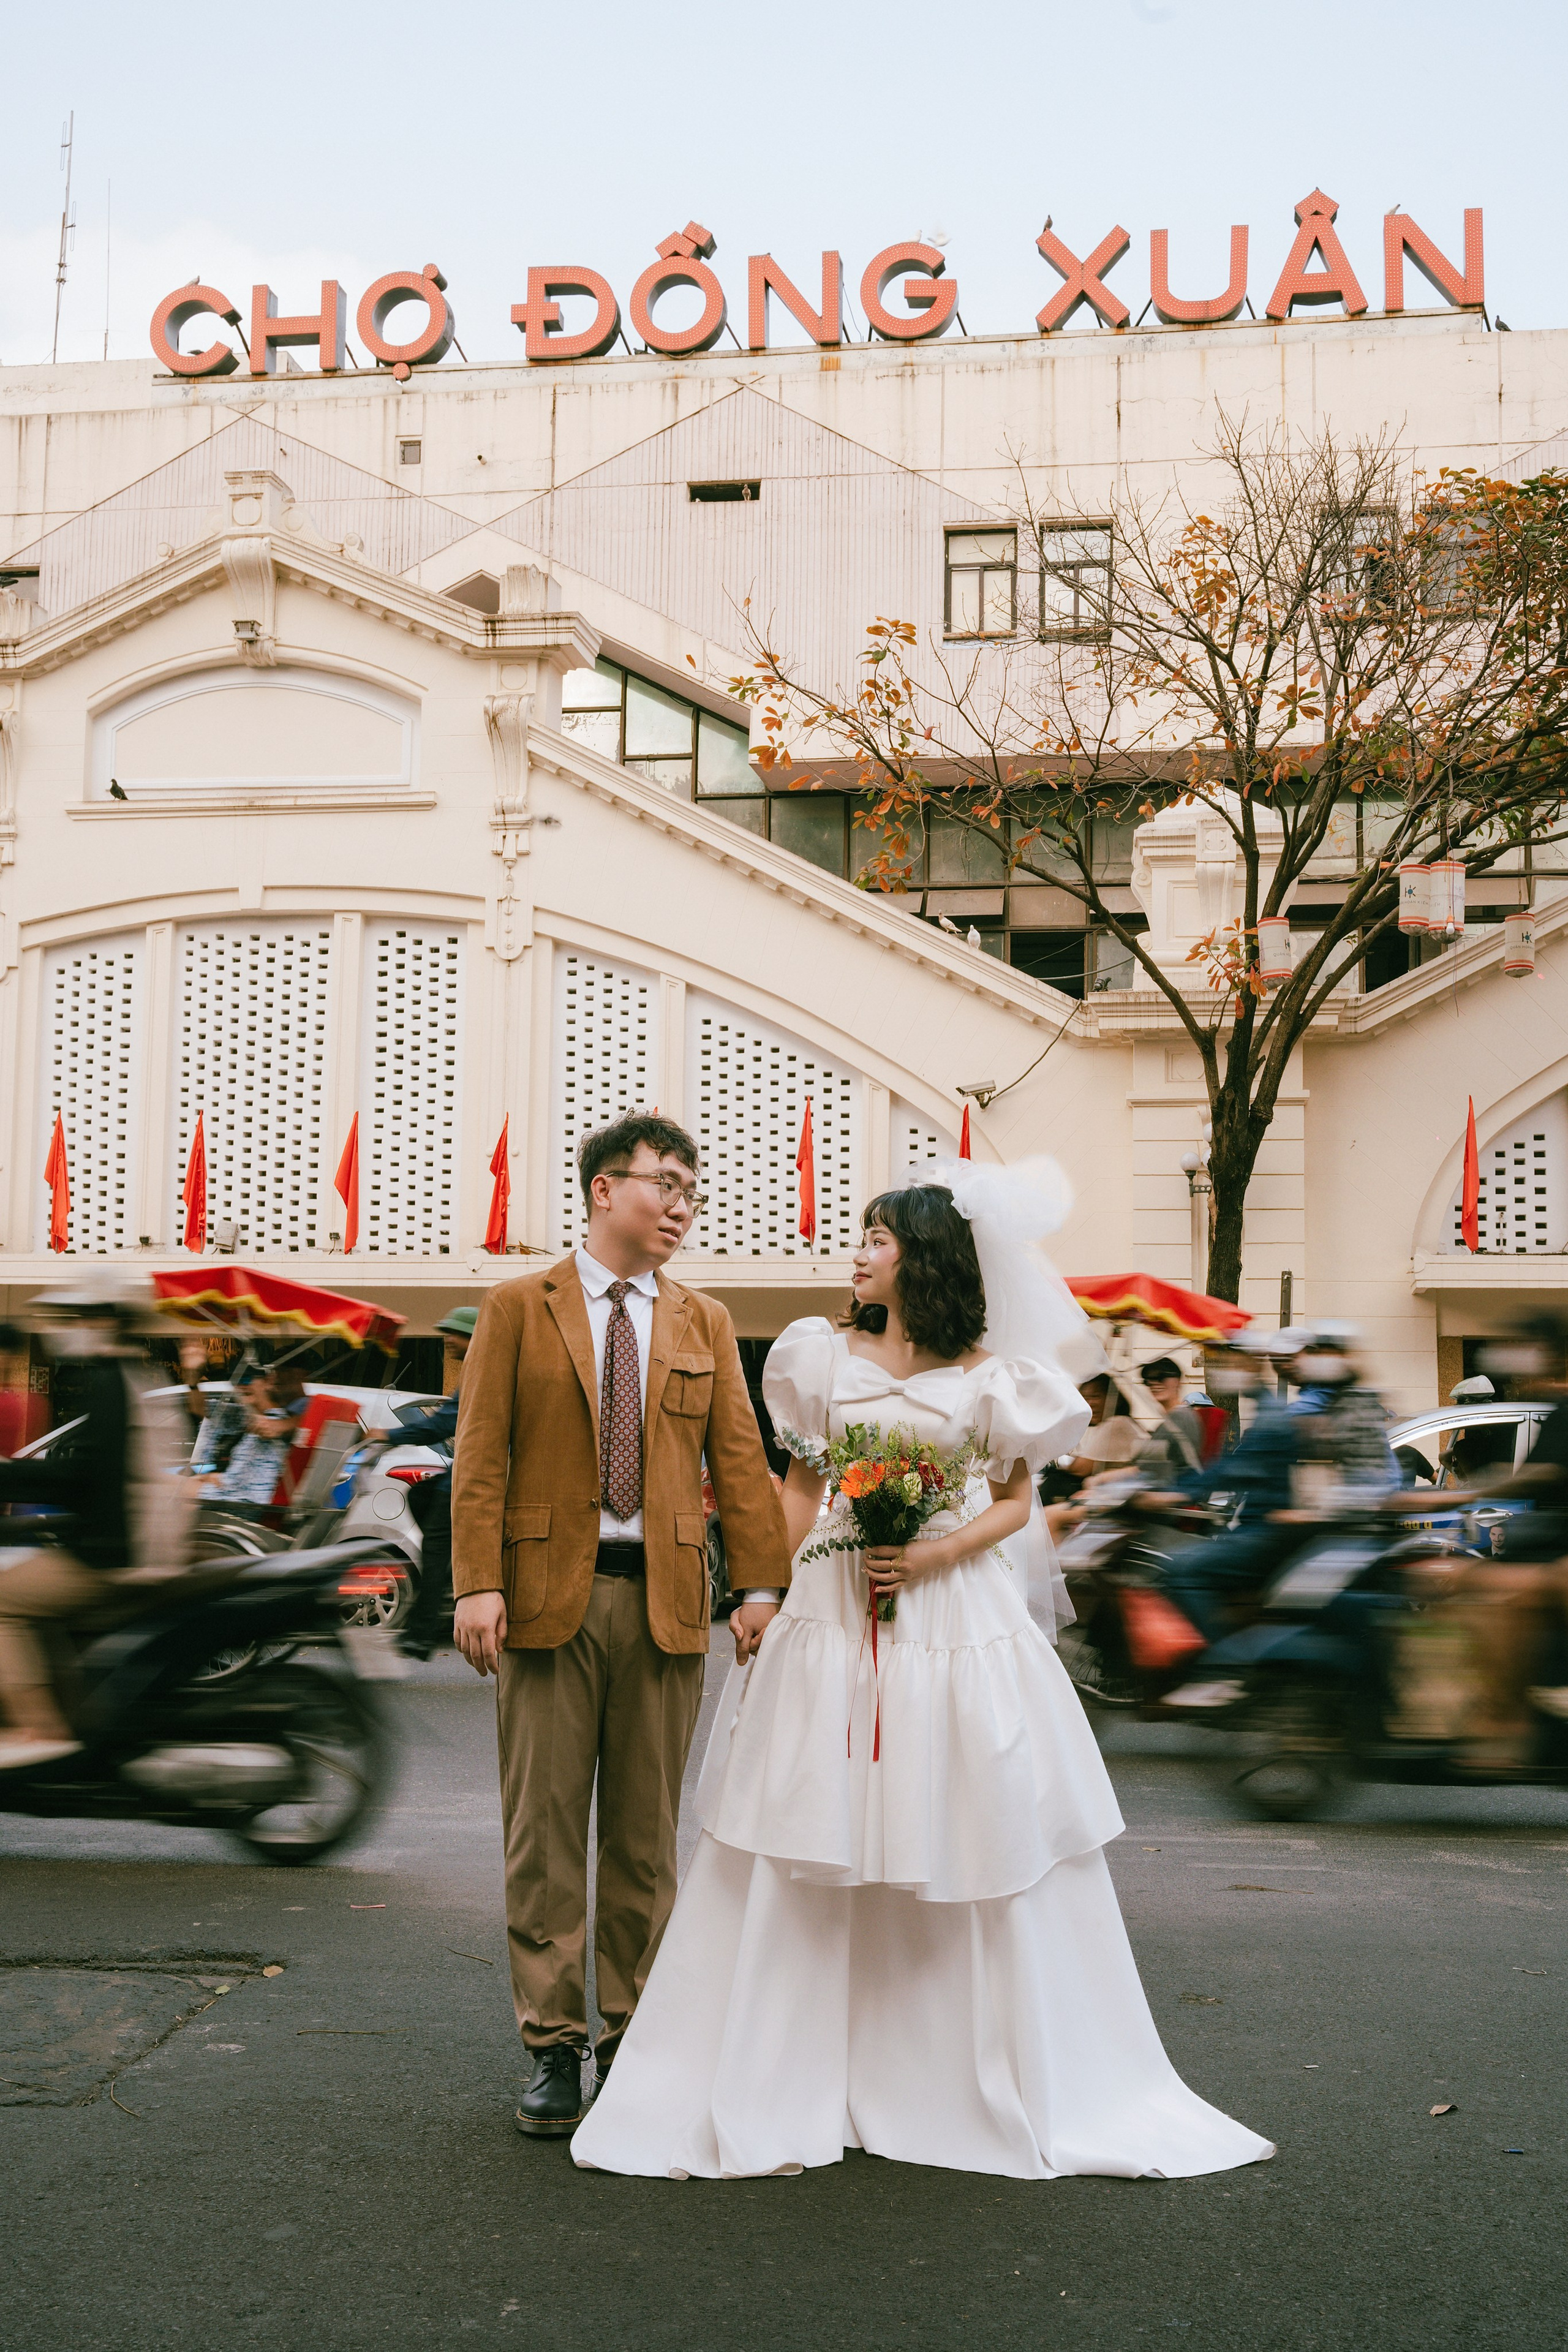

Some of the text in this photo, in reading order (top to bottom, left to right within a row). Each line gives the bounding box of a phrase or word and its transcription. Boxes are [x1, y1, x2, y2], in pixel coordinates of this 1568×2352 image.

[150, 189, 1485, 381] CHỢ ĐỒNG XUÂN
